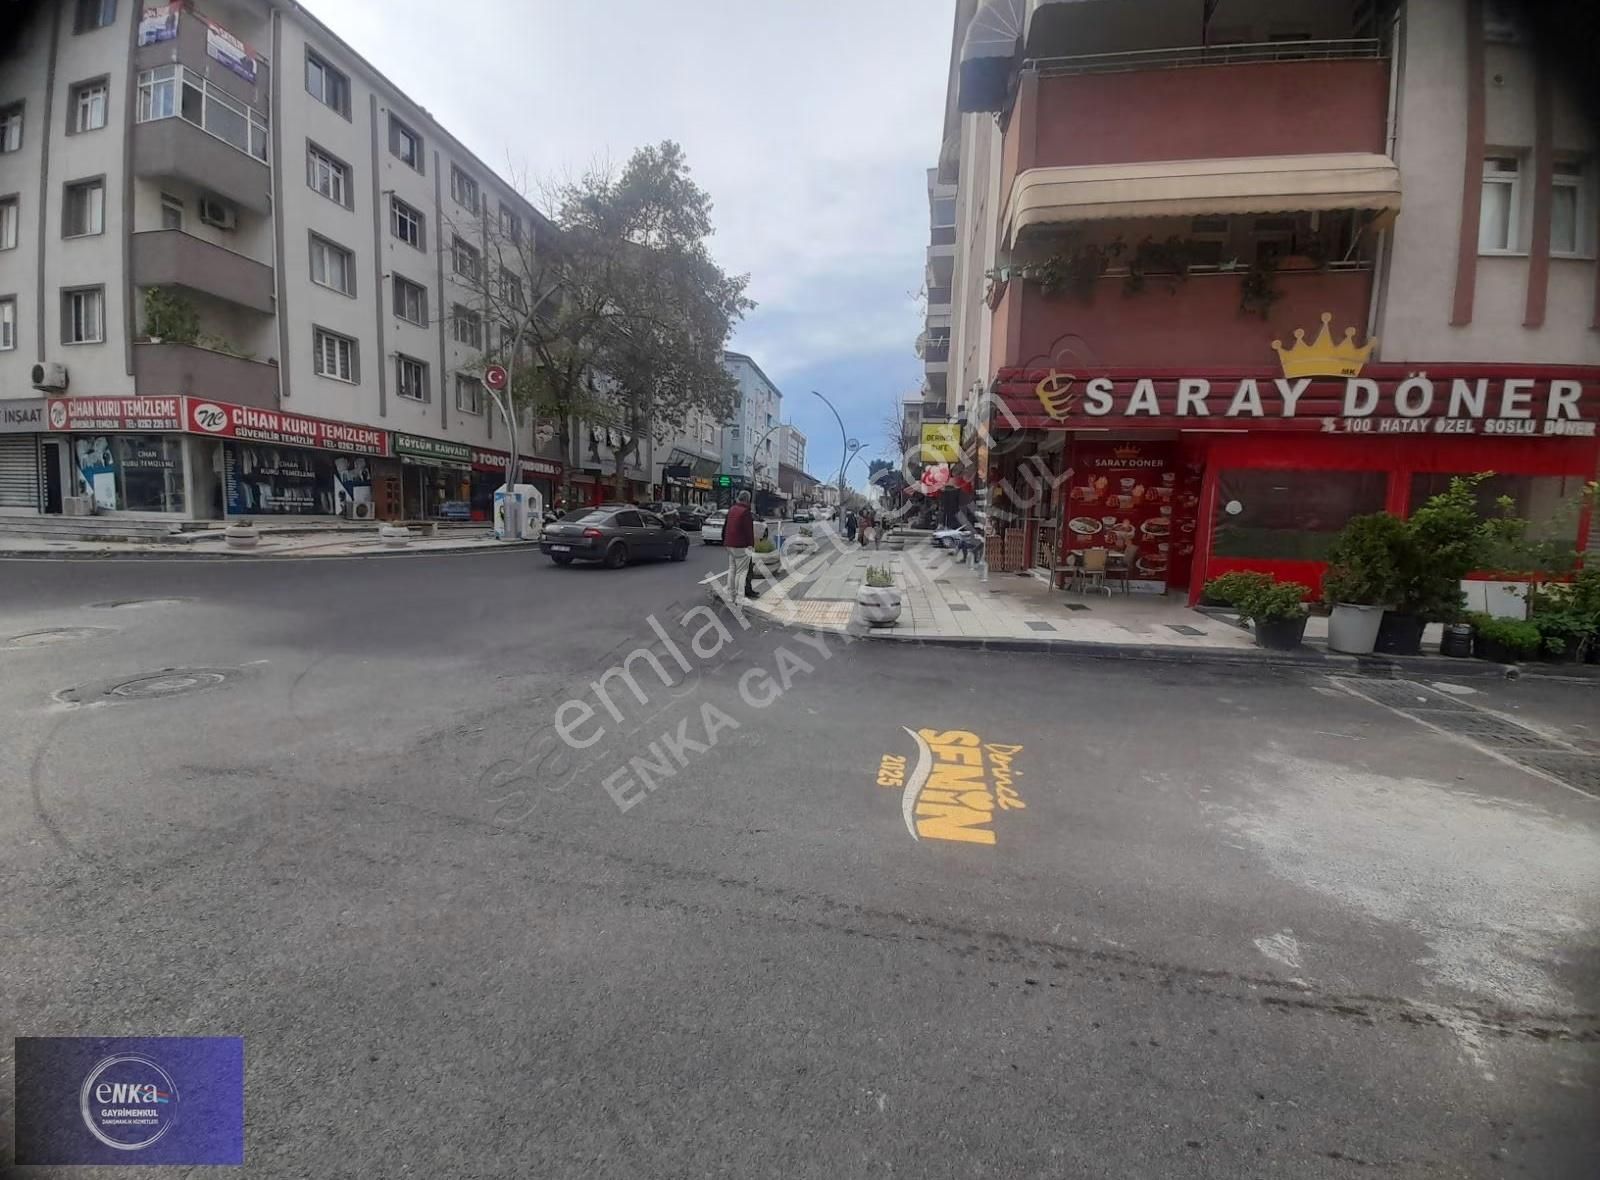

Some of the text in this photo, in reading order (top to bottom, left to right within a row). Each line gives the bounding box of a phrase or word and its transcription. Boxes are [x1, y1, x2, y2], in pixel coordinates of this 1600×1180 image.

[1083, 371, 1583, 420] SARAY DÖNER
[68, 397, 176, 417] CİHAN KURU TEMİZLEME
[232, 406, 381, 446] CİHAN KURU TEMİZLEME
[1344, 418, 1372, 432] 100
[1380, 418, 1431, 433] HATAY
[1434, 416, 1475, 434] ÖZEL
[1484, 418, 1535, 434] SOSLU
[1544, 418, 1596, 437] DÖNER
[235, 427, 280, 442] GÜVENİLİR
[281, 433, 315, 446] TEMİZLİK
[517, 460, 555, 474] ONDURMA
[1095, 458, 1127, 467] SARAY
[876, 754, 907, 787] 2025
